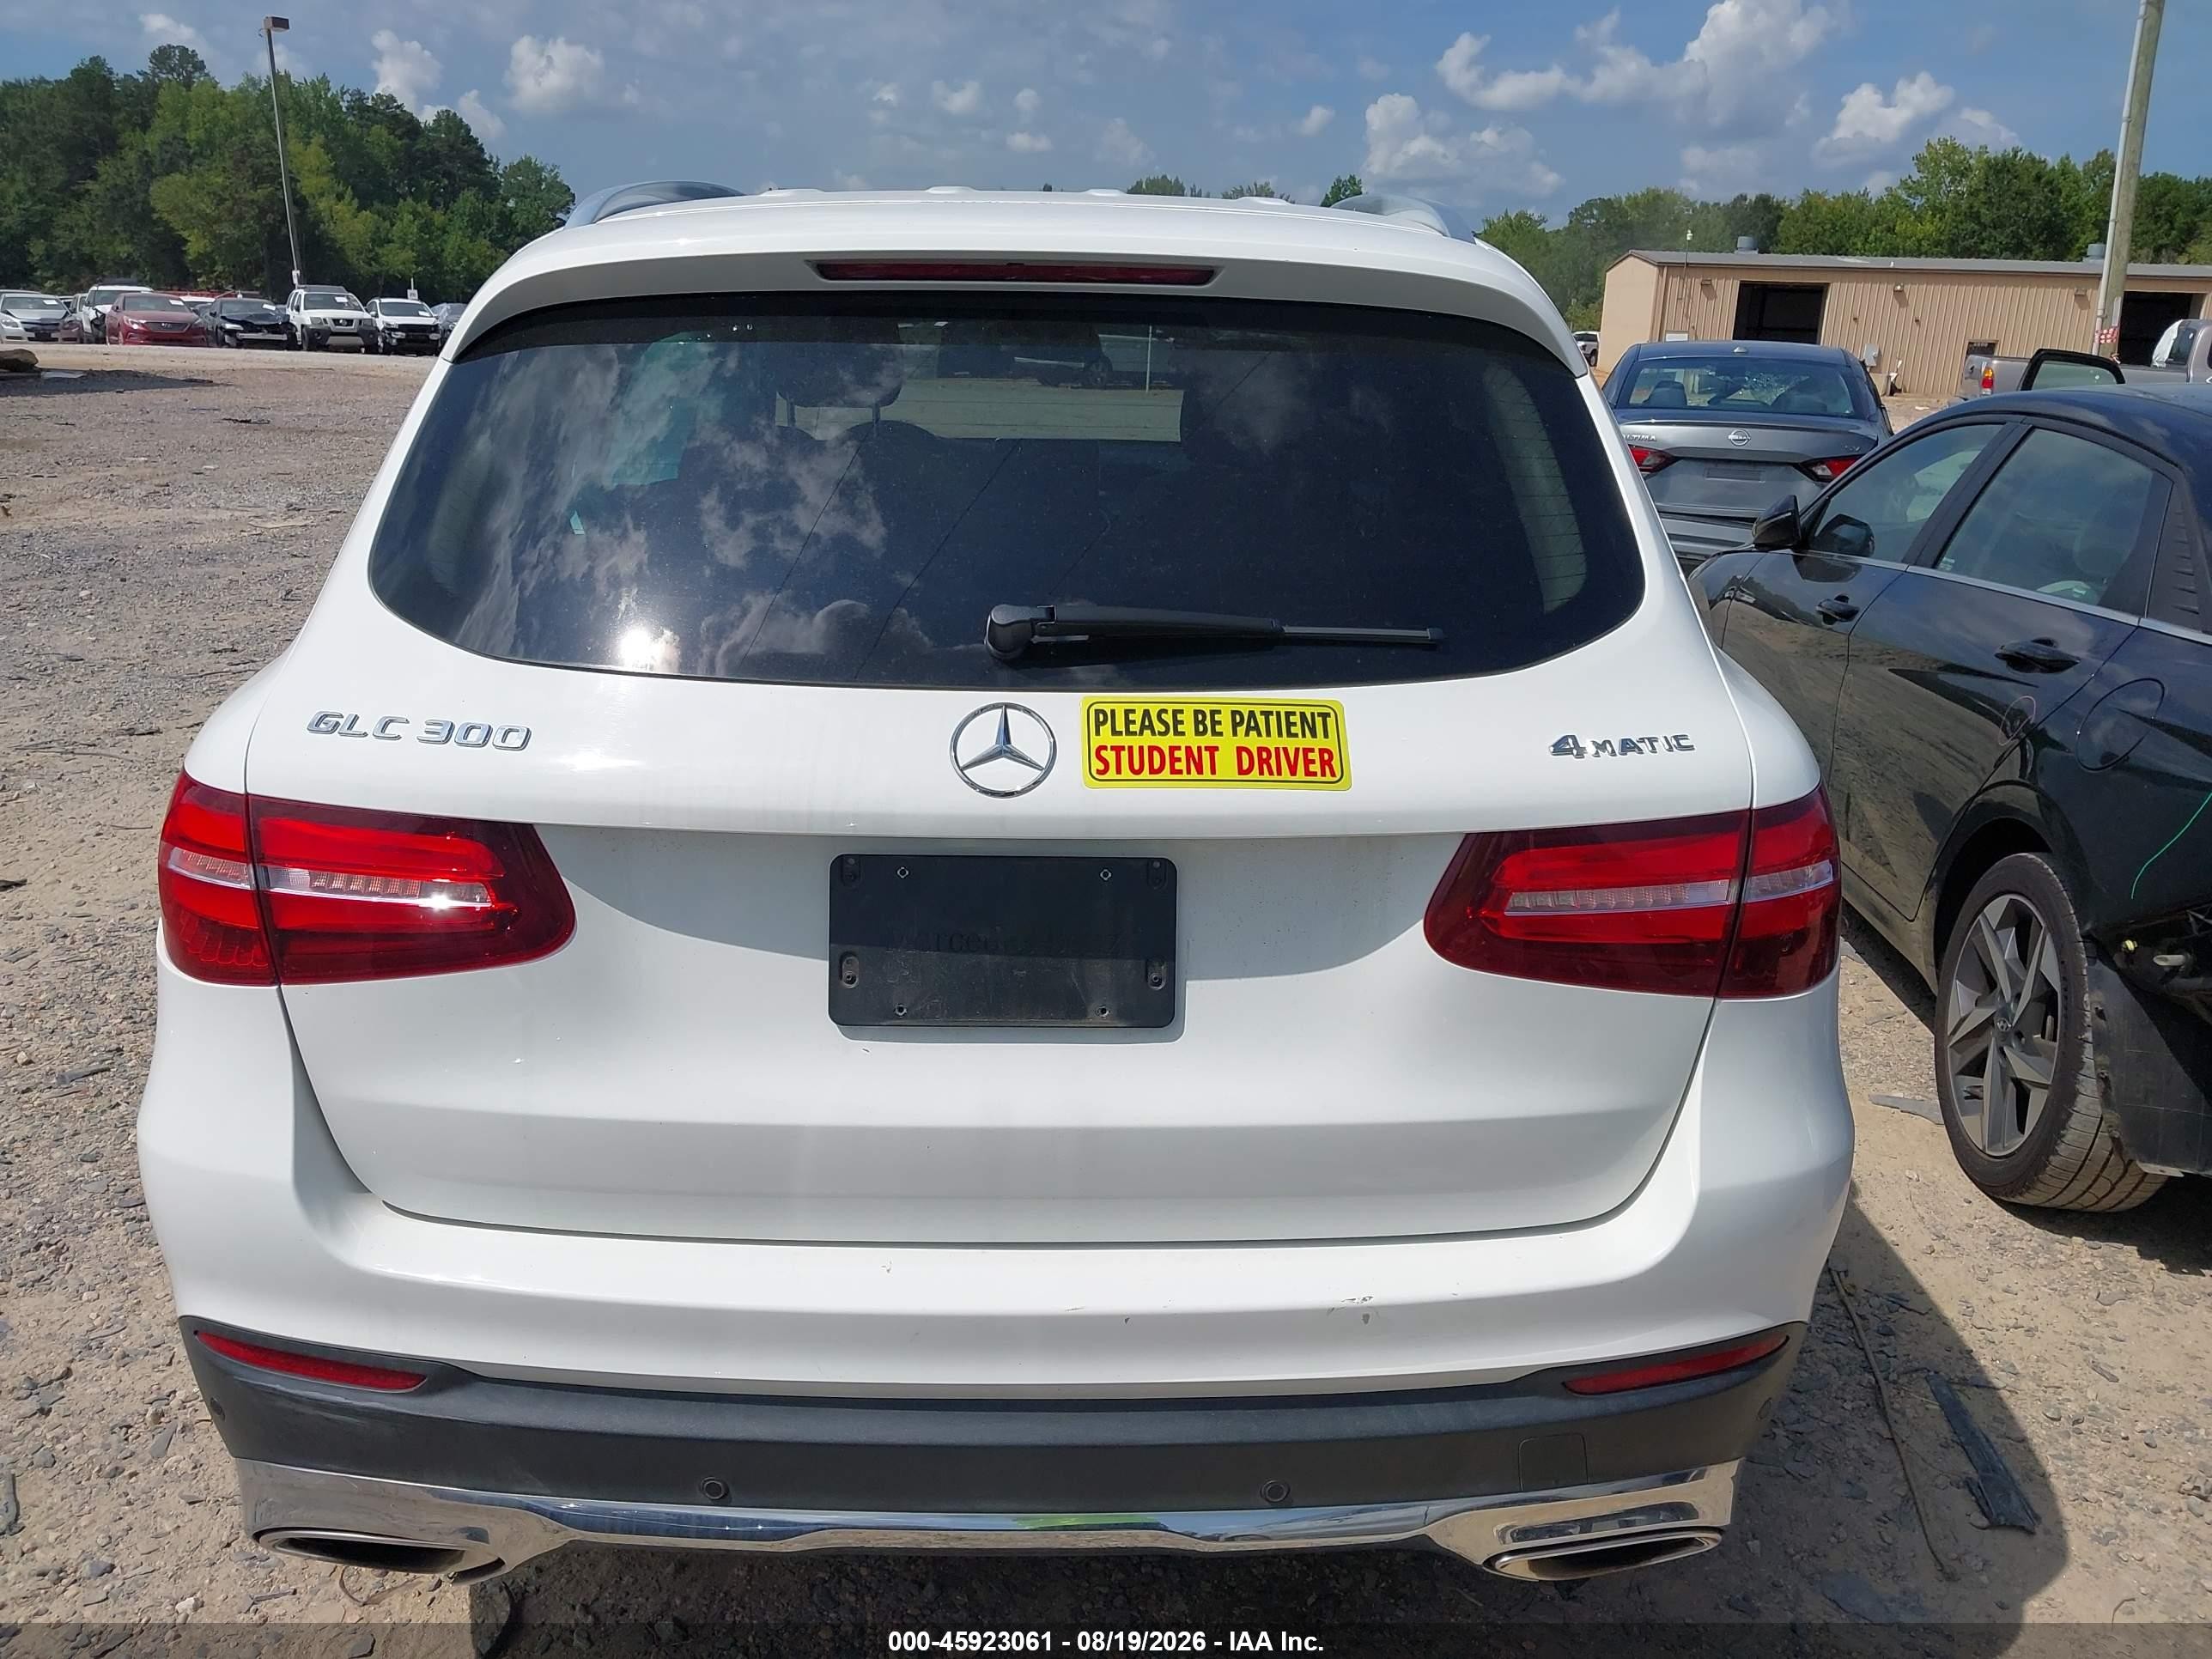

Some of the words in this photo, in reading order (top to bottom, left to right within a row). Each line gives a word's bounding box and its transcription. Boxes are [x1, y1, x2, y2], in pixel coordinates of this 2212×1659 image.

[307, 711, 410, 741] GLC
[416, 719, 532, 751] 300
[1093, 708, 1185, 737] PLEASE
[1193, 708, 1224, 738] BE
[1231, 709, 1332, 739] PATIENT
[1094, 744, 1219, 776] STUDENT
[1236, 745, 1337, 778] DRIVER
